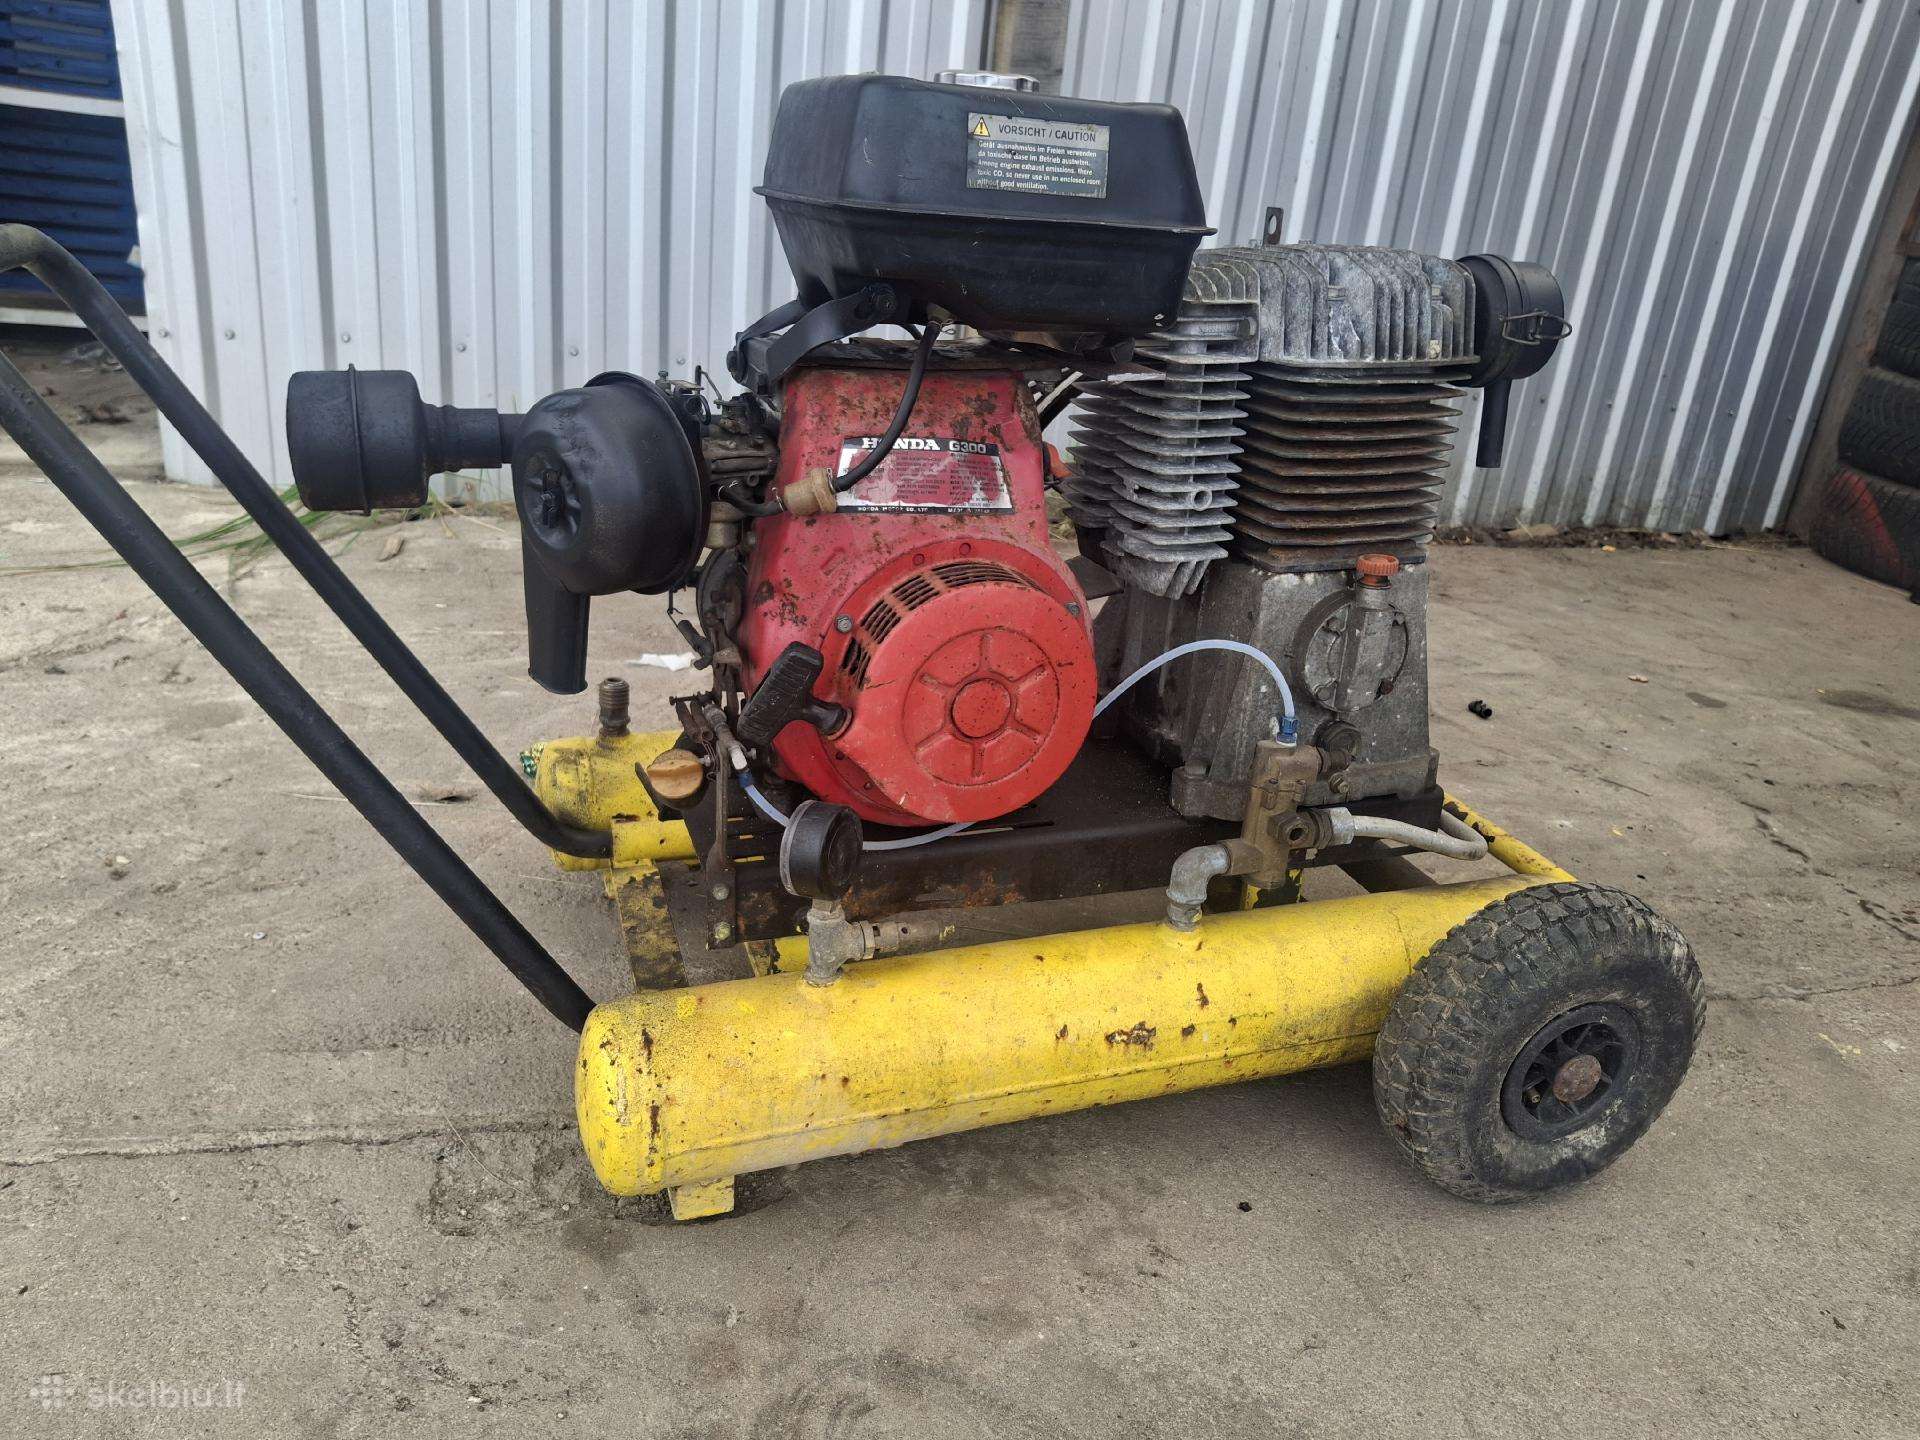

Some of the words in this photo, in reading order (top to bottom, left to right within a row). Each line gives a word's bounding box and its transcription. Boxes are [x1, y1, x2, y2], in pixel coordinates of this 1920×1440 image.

[999, 124, 1046, 138] VORSICHT
[1055, 130, 1096, 142] CAUTION
[978, 140, 995, 149] Gerät
[1046, 147, 1065, 155] Freien
[1000, 161, 1020, 170] engine
[1021, 163, 1045, 171] exhaust
[1014, 172, 1030, 180] never
[1000, 180, 1015, 189] good
[862, 437, 941, 451] HNDA
[949, 440, 987, 454] G300
